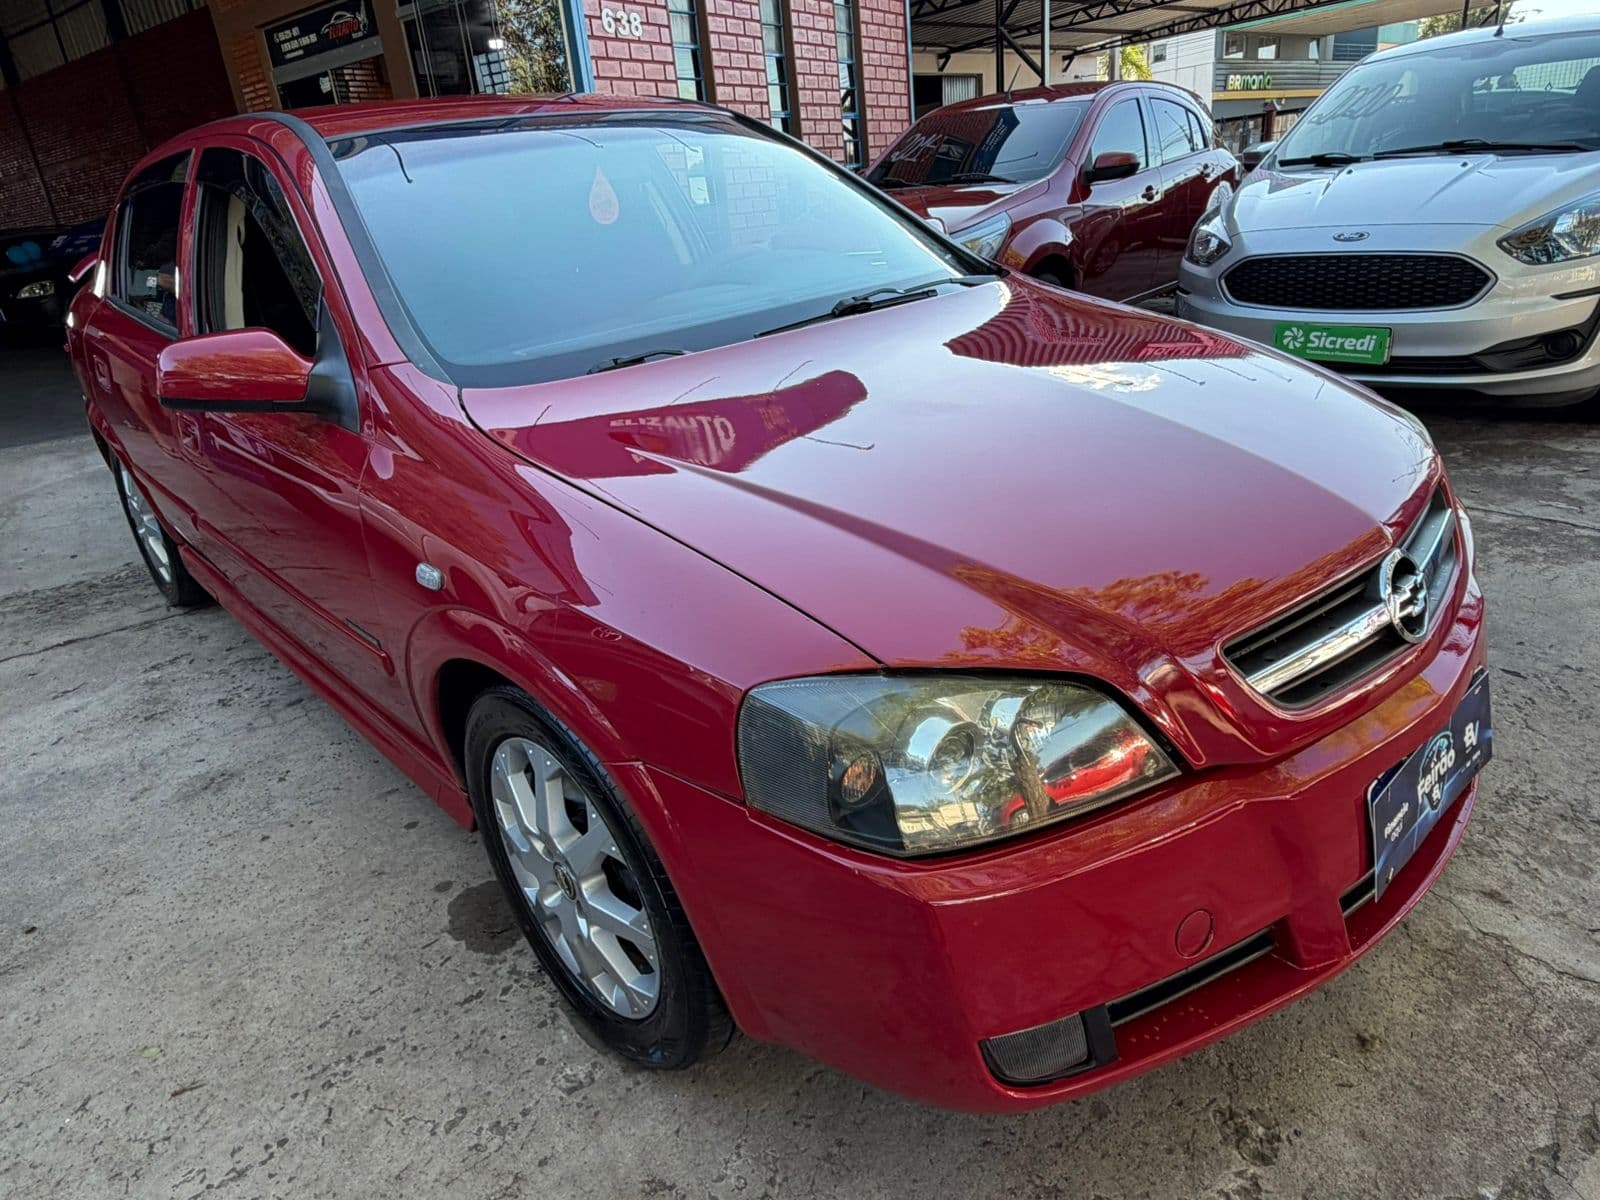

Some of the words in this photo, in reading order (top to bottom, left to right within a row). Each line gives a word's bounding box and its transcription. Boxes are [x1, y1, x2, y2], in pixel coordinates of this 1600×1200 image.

[602, 8, 643, 37] 638
[1307, 332, 1377, 351] Sicredi
[1417, 746, 1456, 805] Feirão
